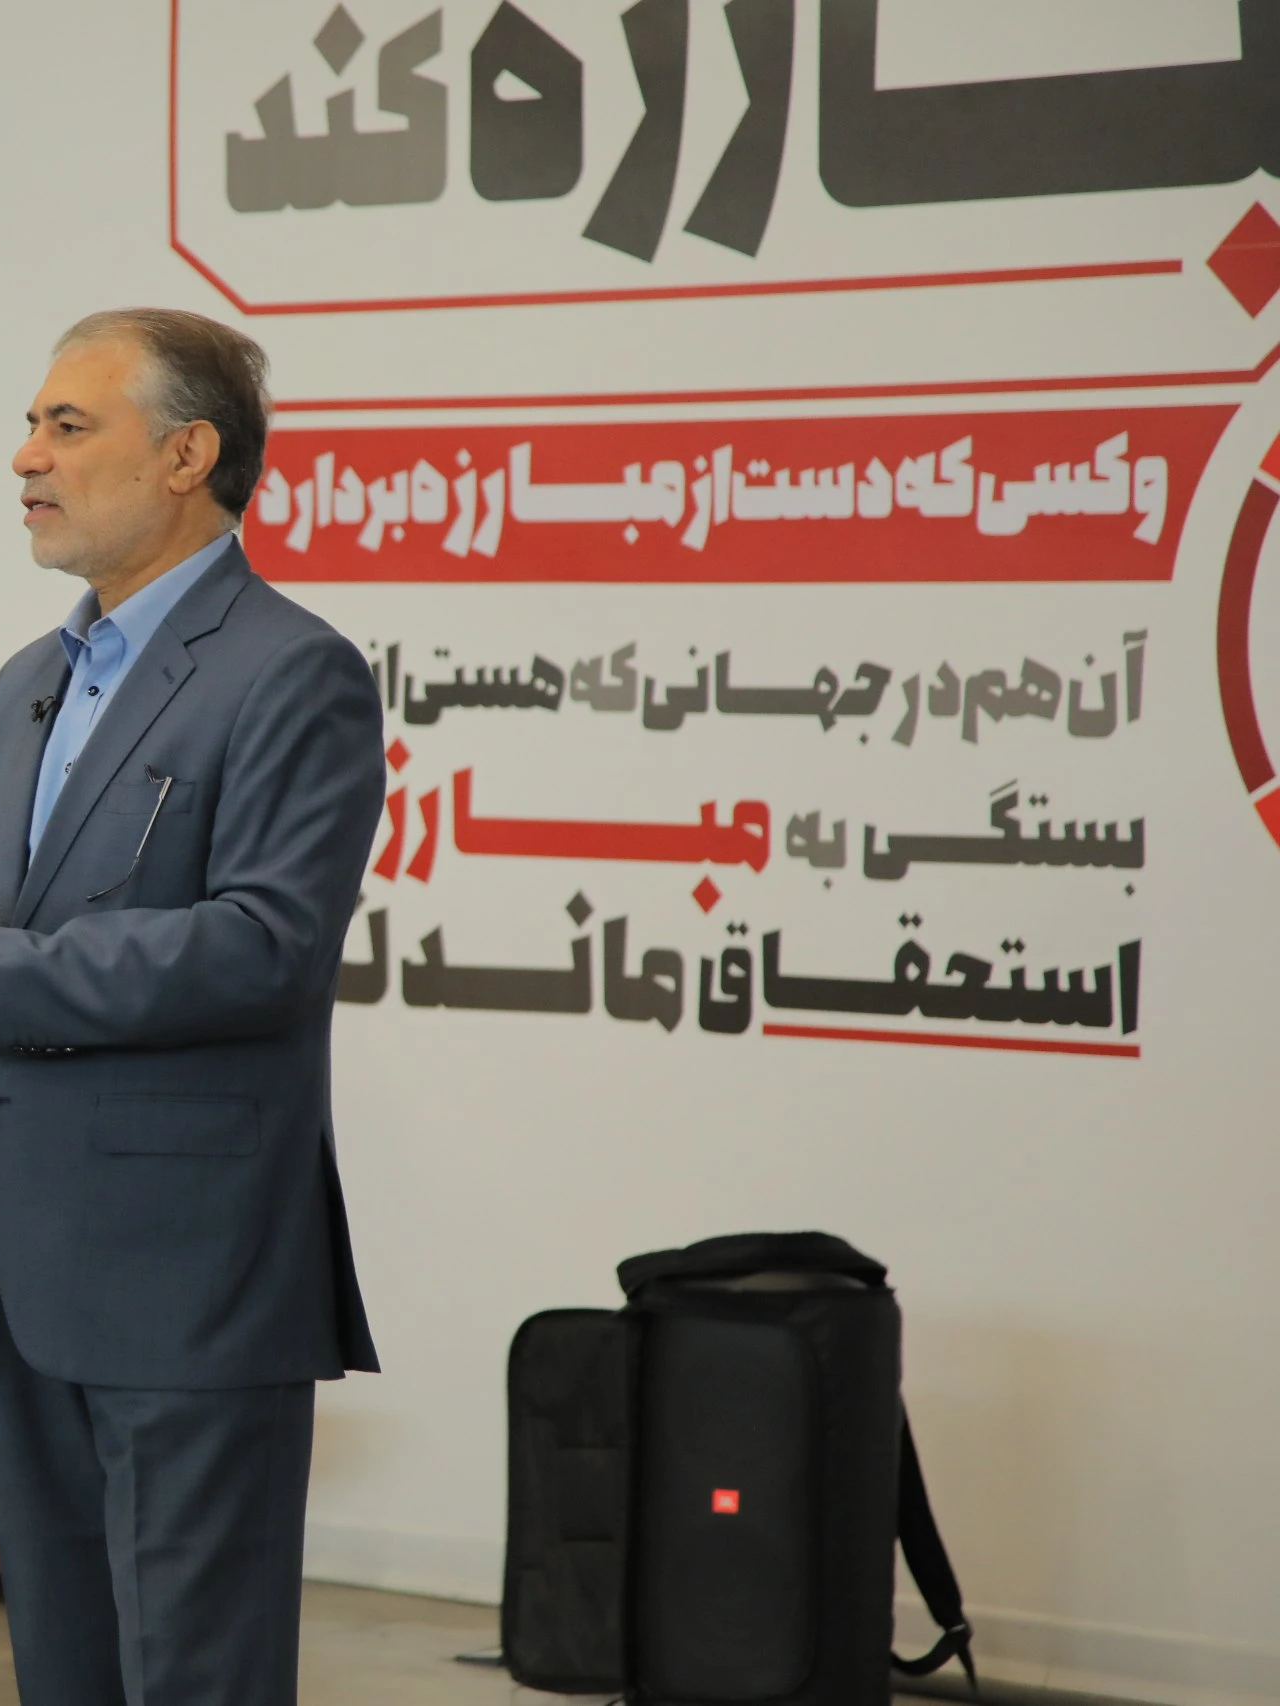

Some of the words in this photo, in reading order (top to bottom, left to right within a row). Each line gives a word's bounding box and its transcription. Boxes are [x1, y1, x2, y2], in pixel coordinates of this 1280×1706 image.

[225, 3, 448, 214] کند
[257, 451, 410, 553] بردارد
[410, 441, 686, 558] مبارزه
[680, 443, 733, 552] از
[732, 455, 894, 519] دست
[894, 435, 975, 518] که
[403, 646, 566, 727] هستی
[569, 641, 638, 712] که
[641, 645, 893, 746] جهانی
[891, 660, 961, 748] در
[960, 656, 1063, 746] هم
[1067, 628, 1149, 740] آن
[372, 736, 771, 915] مبارز
[785, 809, 847, 891] به
[863, 777, 1147, 898] بستگی
[698, 911, 1143, 1038] استحقاق
